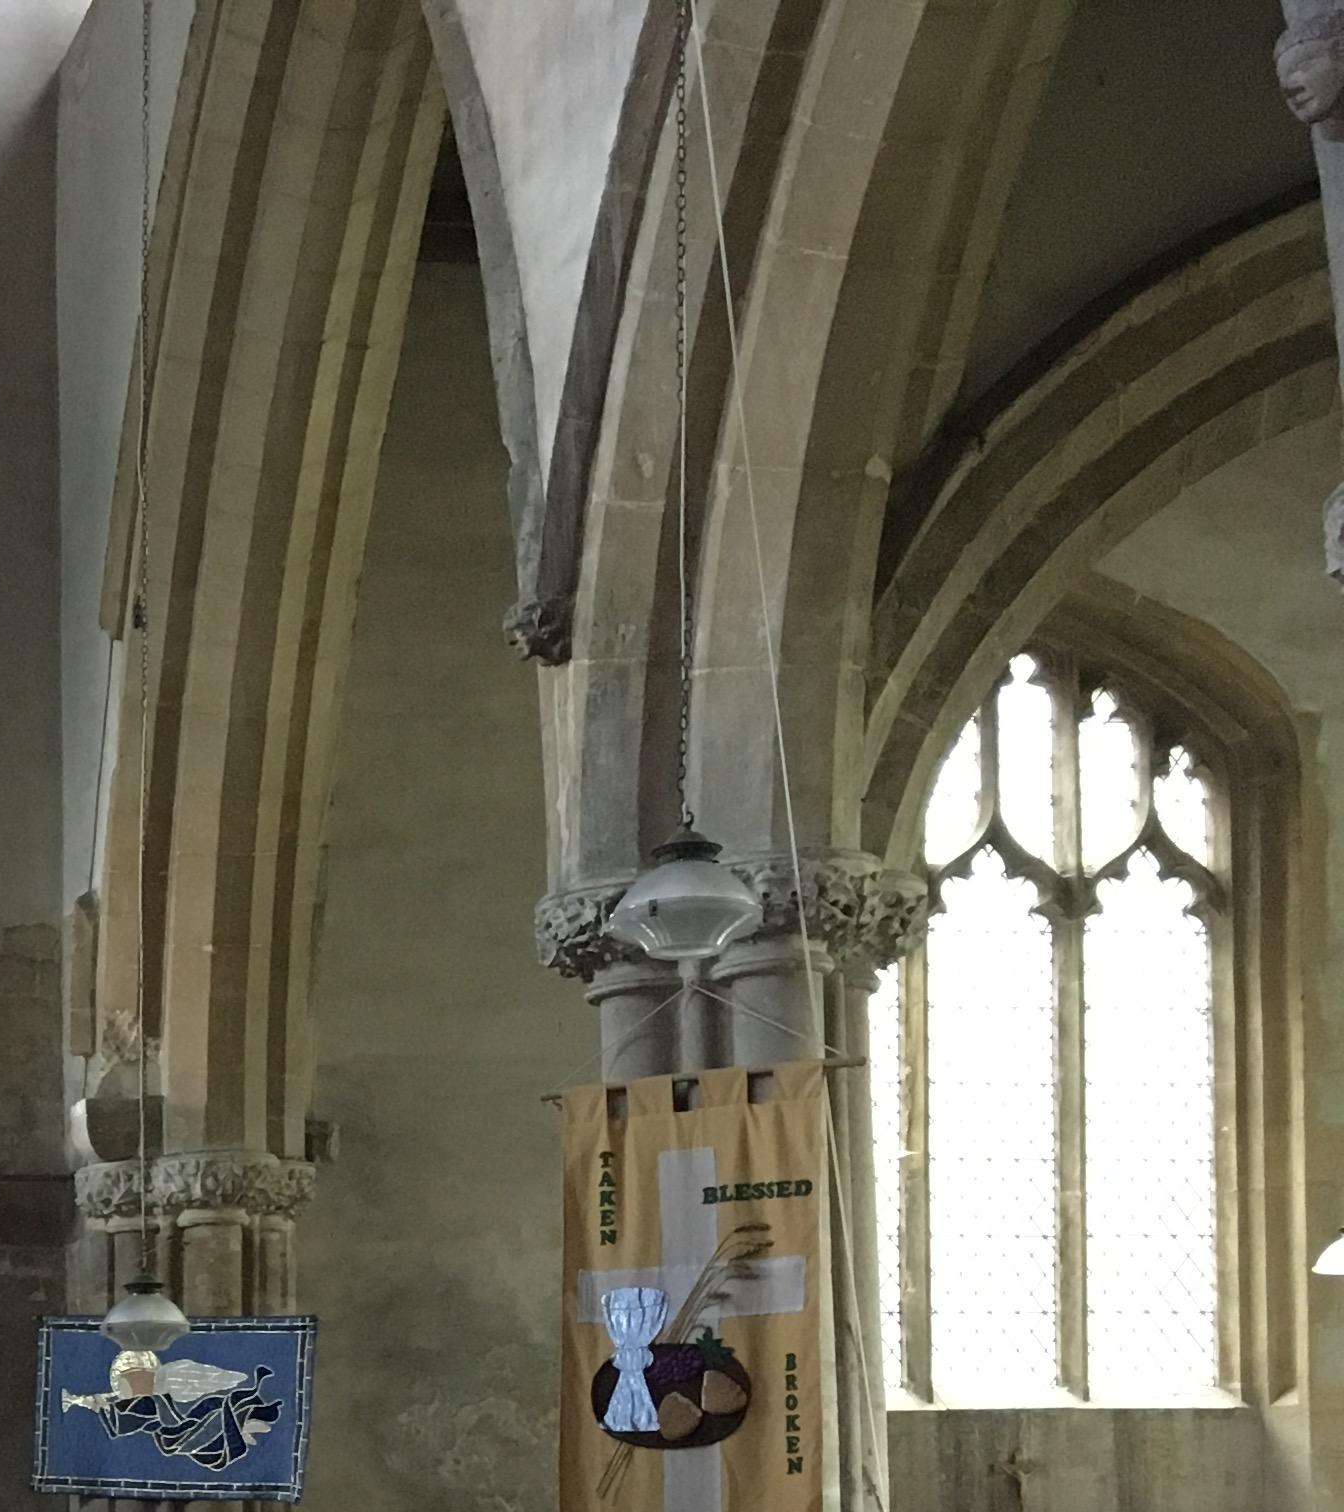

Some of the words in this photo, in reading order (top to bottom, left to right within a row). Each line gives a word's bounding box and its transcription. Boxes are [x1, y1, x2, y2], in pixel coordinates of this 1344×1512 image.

[598, 1151, 618, 1247] TAKEN
[702, 1180, 813, 1205] BLESSED
[785, 1353, 805, 1475] BROKEN
